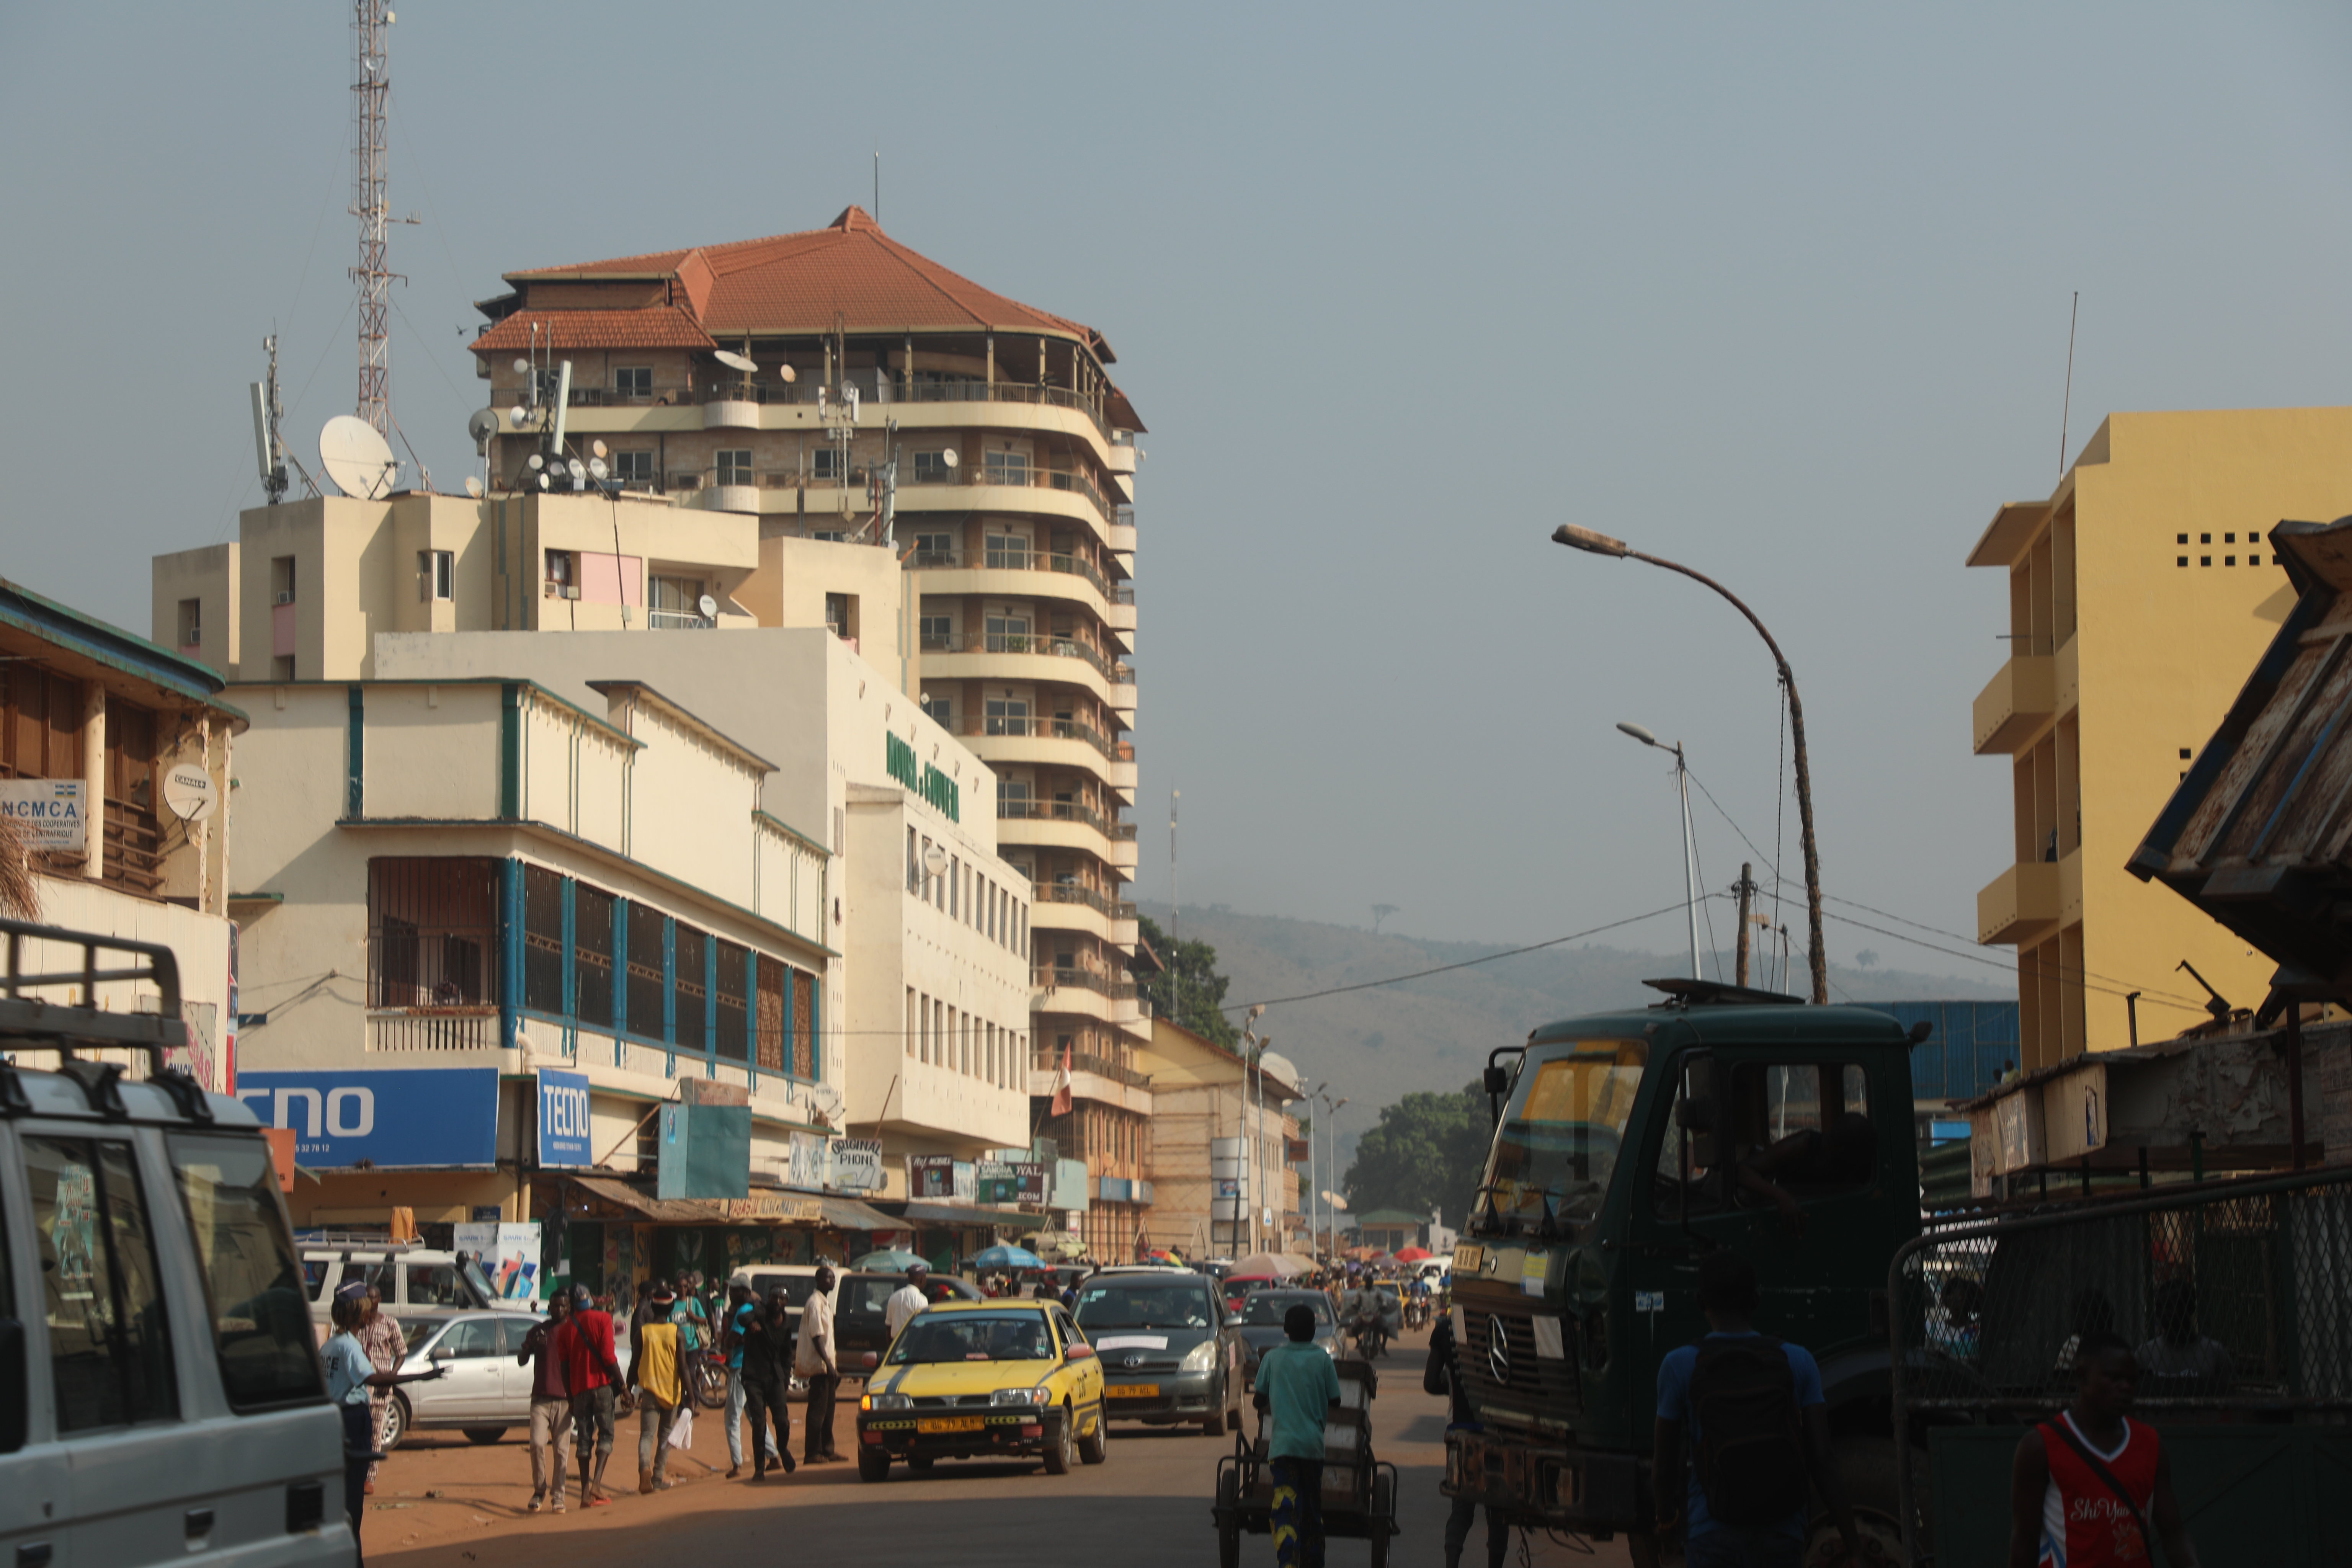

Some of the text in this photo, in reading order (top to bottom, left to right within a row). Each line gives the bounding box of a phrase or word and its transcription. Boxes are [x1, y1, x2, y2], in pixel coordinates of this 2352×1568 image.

[176, 774, 206, 789] CANAL+
[42, 819, 80, 828] COOPERATIVES
[185, 1021, 211, 1091] EGAS
[544, 1084, 588, 1138] TECNO
[322, 1143, 329, 1153] 12
[832, 1139, 880, 1156] ORIGINAL
[840, 1154, 874, 1166] PHONE
[1017, 1192, 1040, 1201] ECOM
